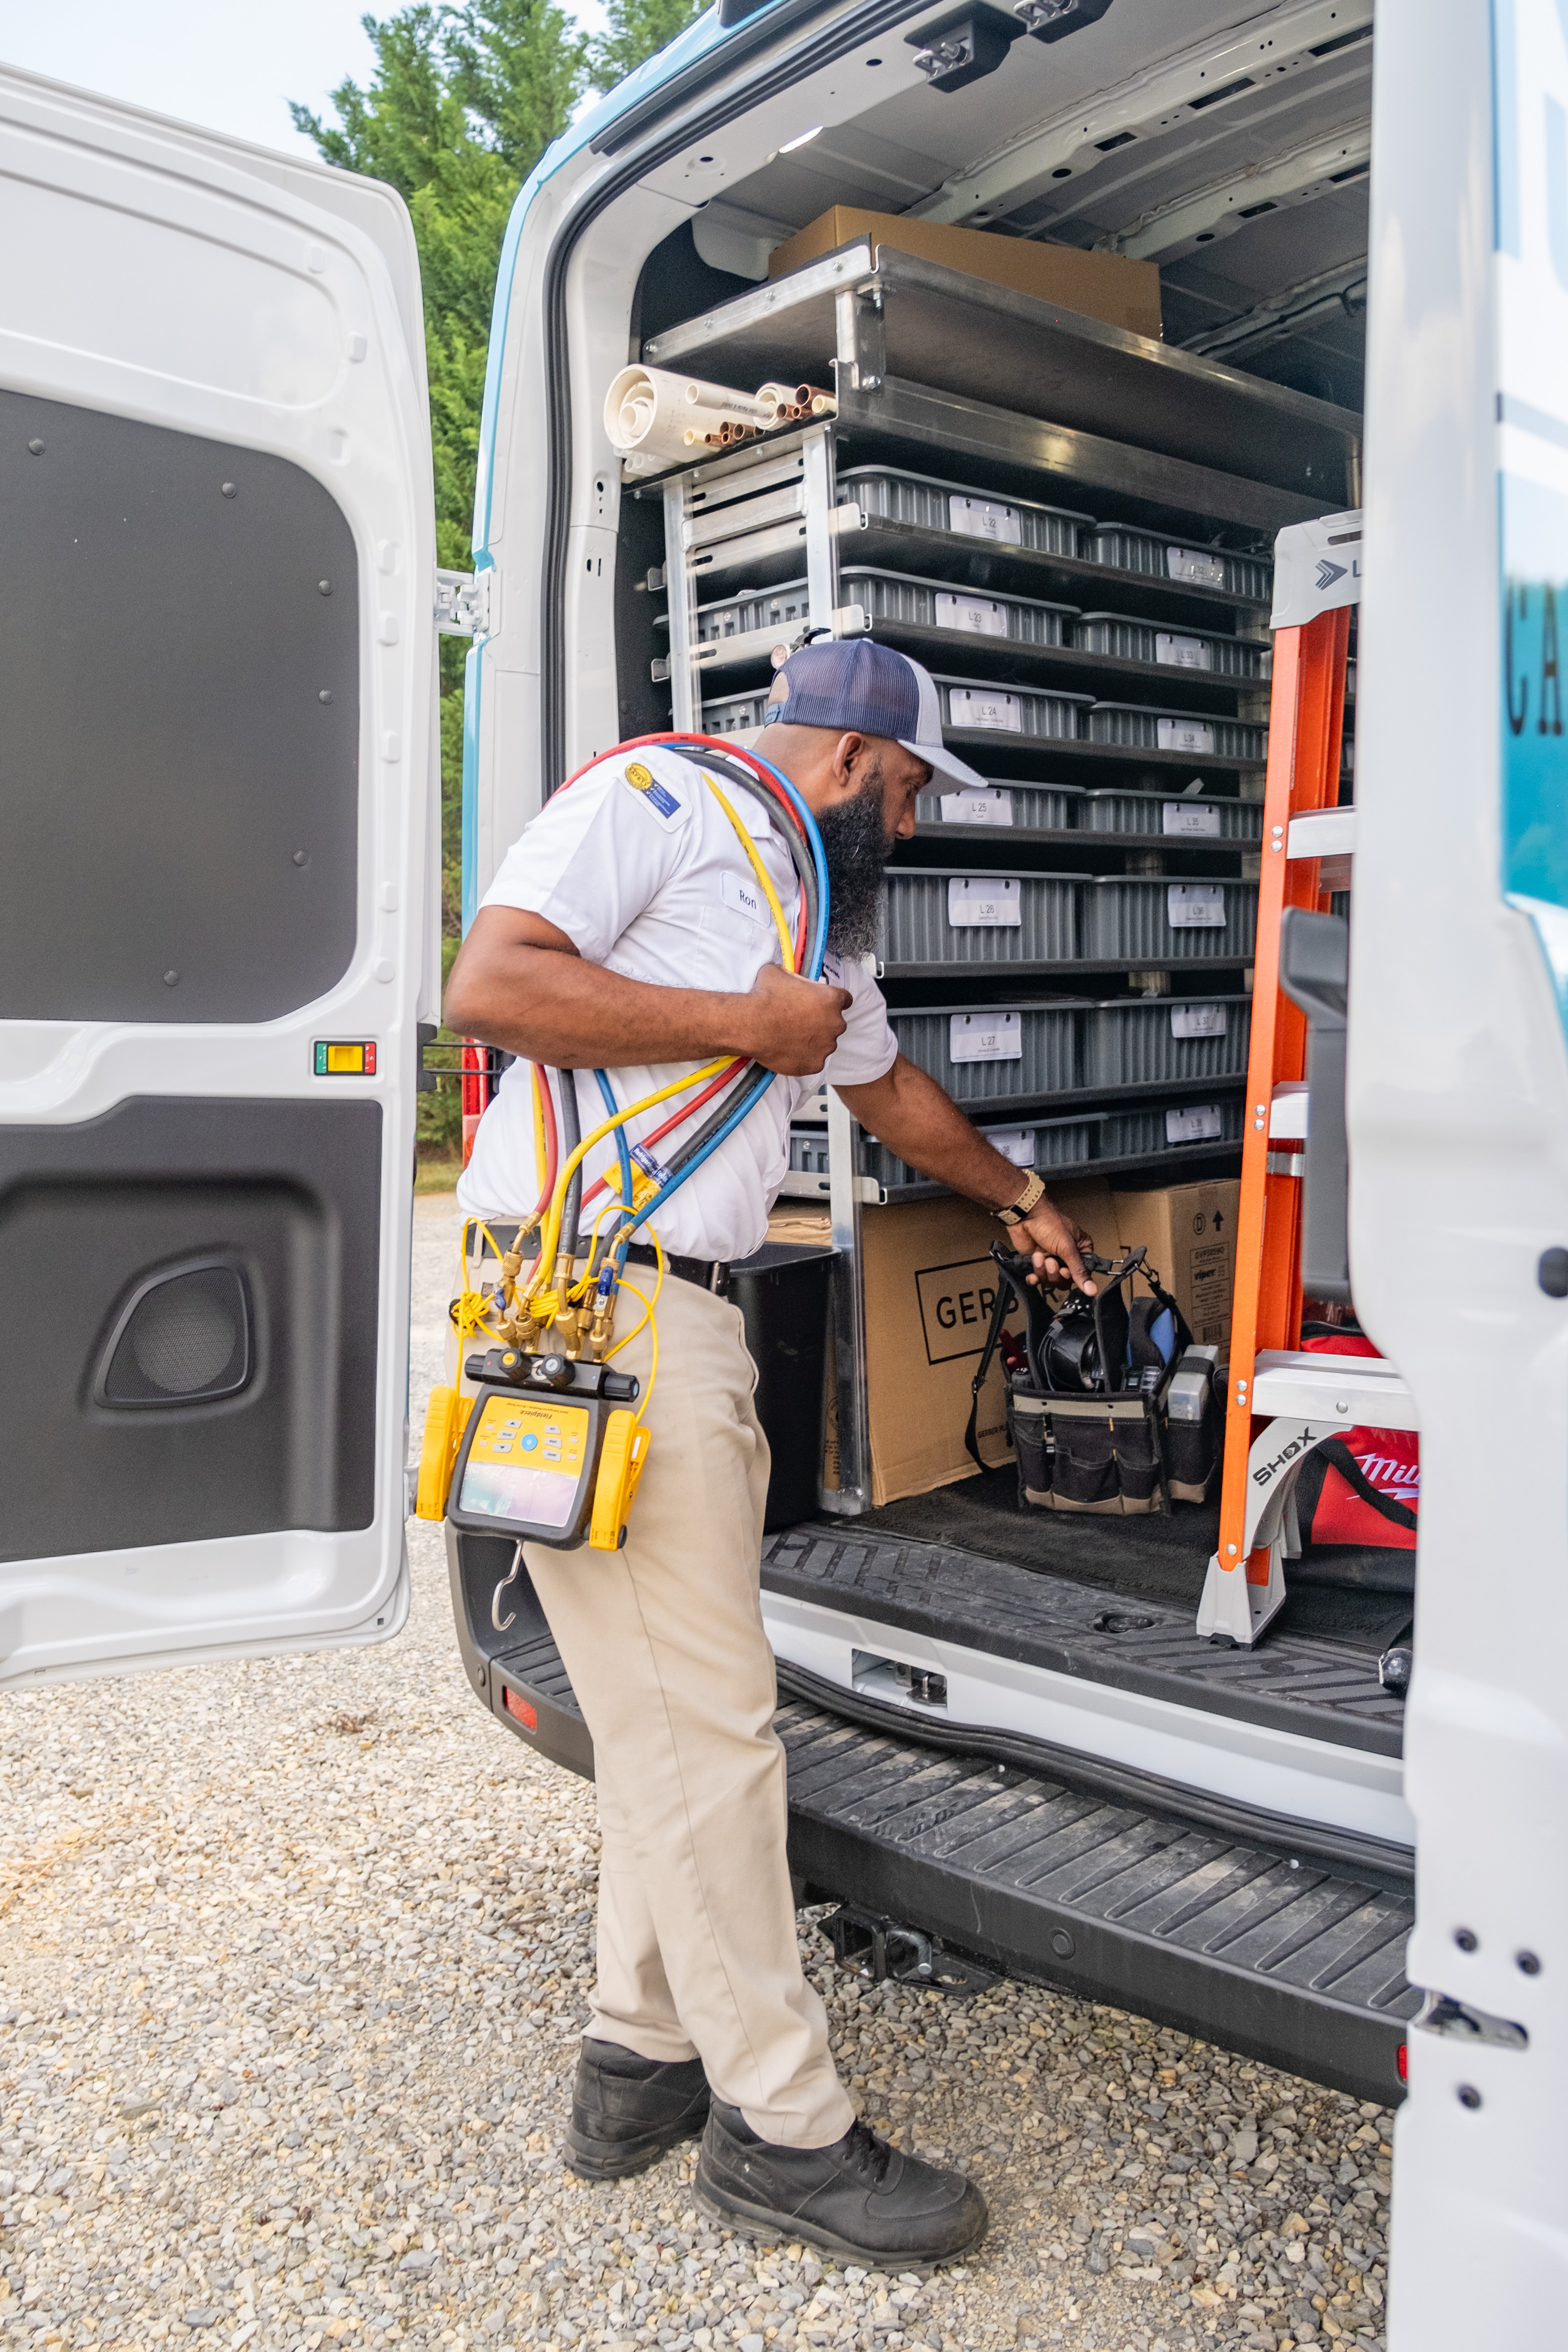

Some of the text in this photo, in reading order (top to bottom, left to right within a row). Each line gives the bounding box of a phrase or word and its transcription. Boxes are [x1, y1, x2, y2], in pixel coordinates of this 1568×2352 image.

[988, 517, 996, 528] 22
[974, 612, 982, 623] 23
[982, 706, 997, 716] L 24
[972, 802, 987, 812] L 25
[739, 890, 757, 910] Ron
[980, 904, 995, 913] L 26
[982, 1036, 995, 1046] L 27
[1003, 1146, 1010, 1155] 28
[519, 1409, 552, 1419] Fieldpiece
[1253, 1426, 1317, 1486] SHOX
[1354, 1453, 1420, 1486] Mil
